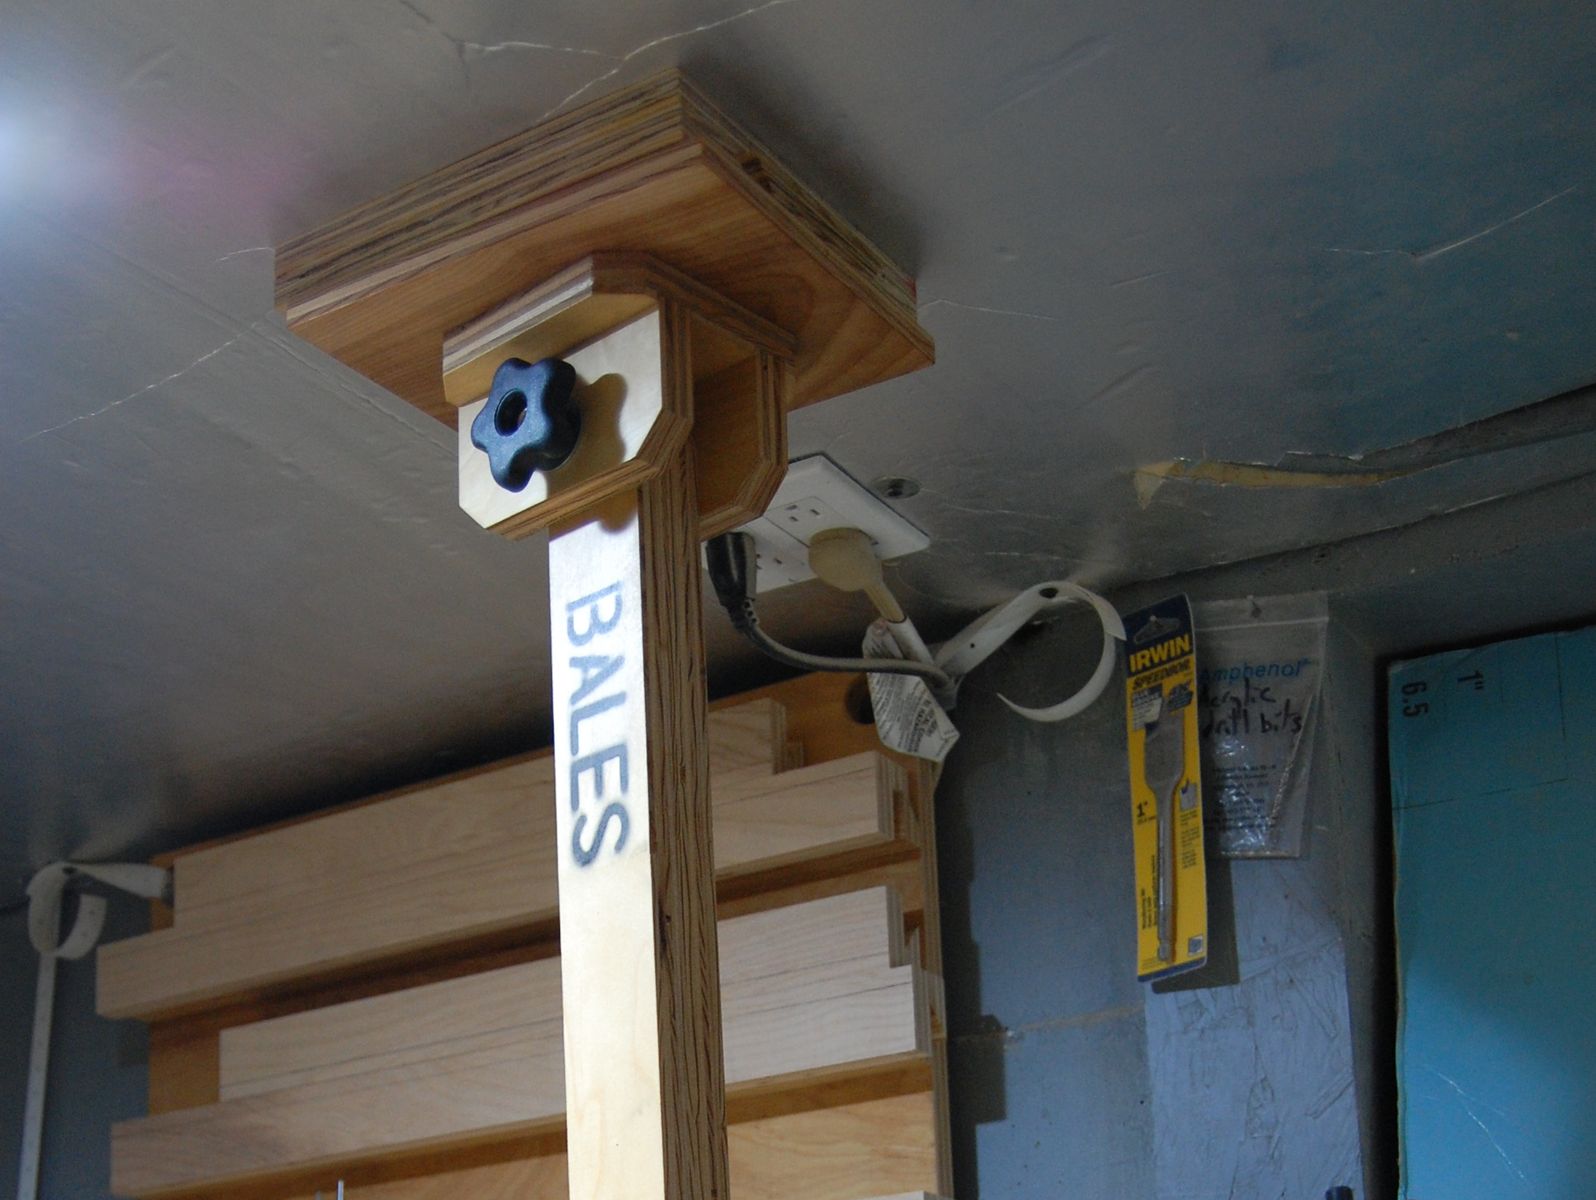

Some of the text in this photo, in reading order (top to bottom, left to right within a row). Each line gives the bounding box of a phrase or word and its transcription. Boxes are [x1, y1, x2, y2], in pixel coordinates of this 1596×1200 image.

[1129, 634, 1191, 674] IRWIN
[565, 580, 632, 870] BALES
[1260, 698, 1304, 735] bits
